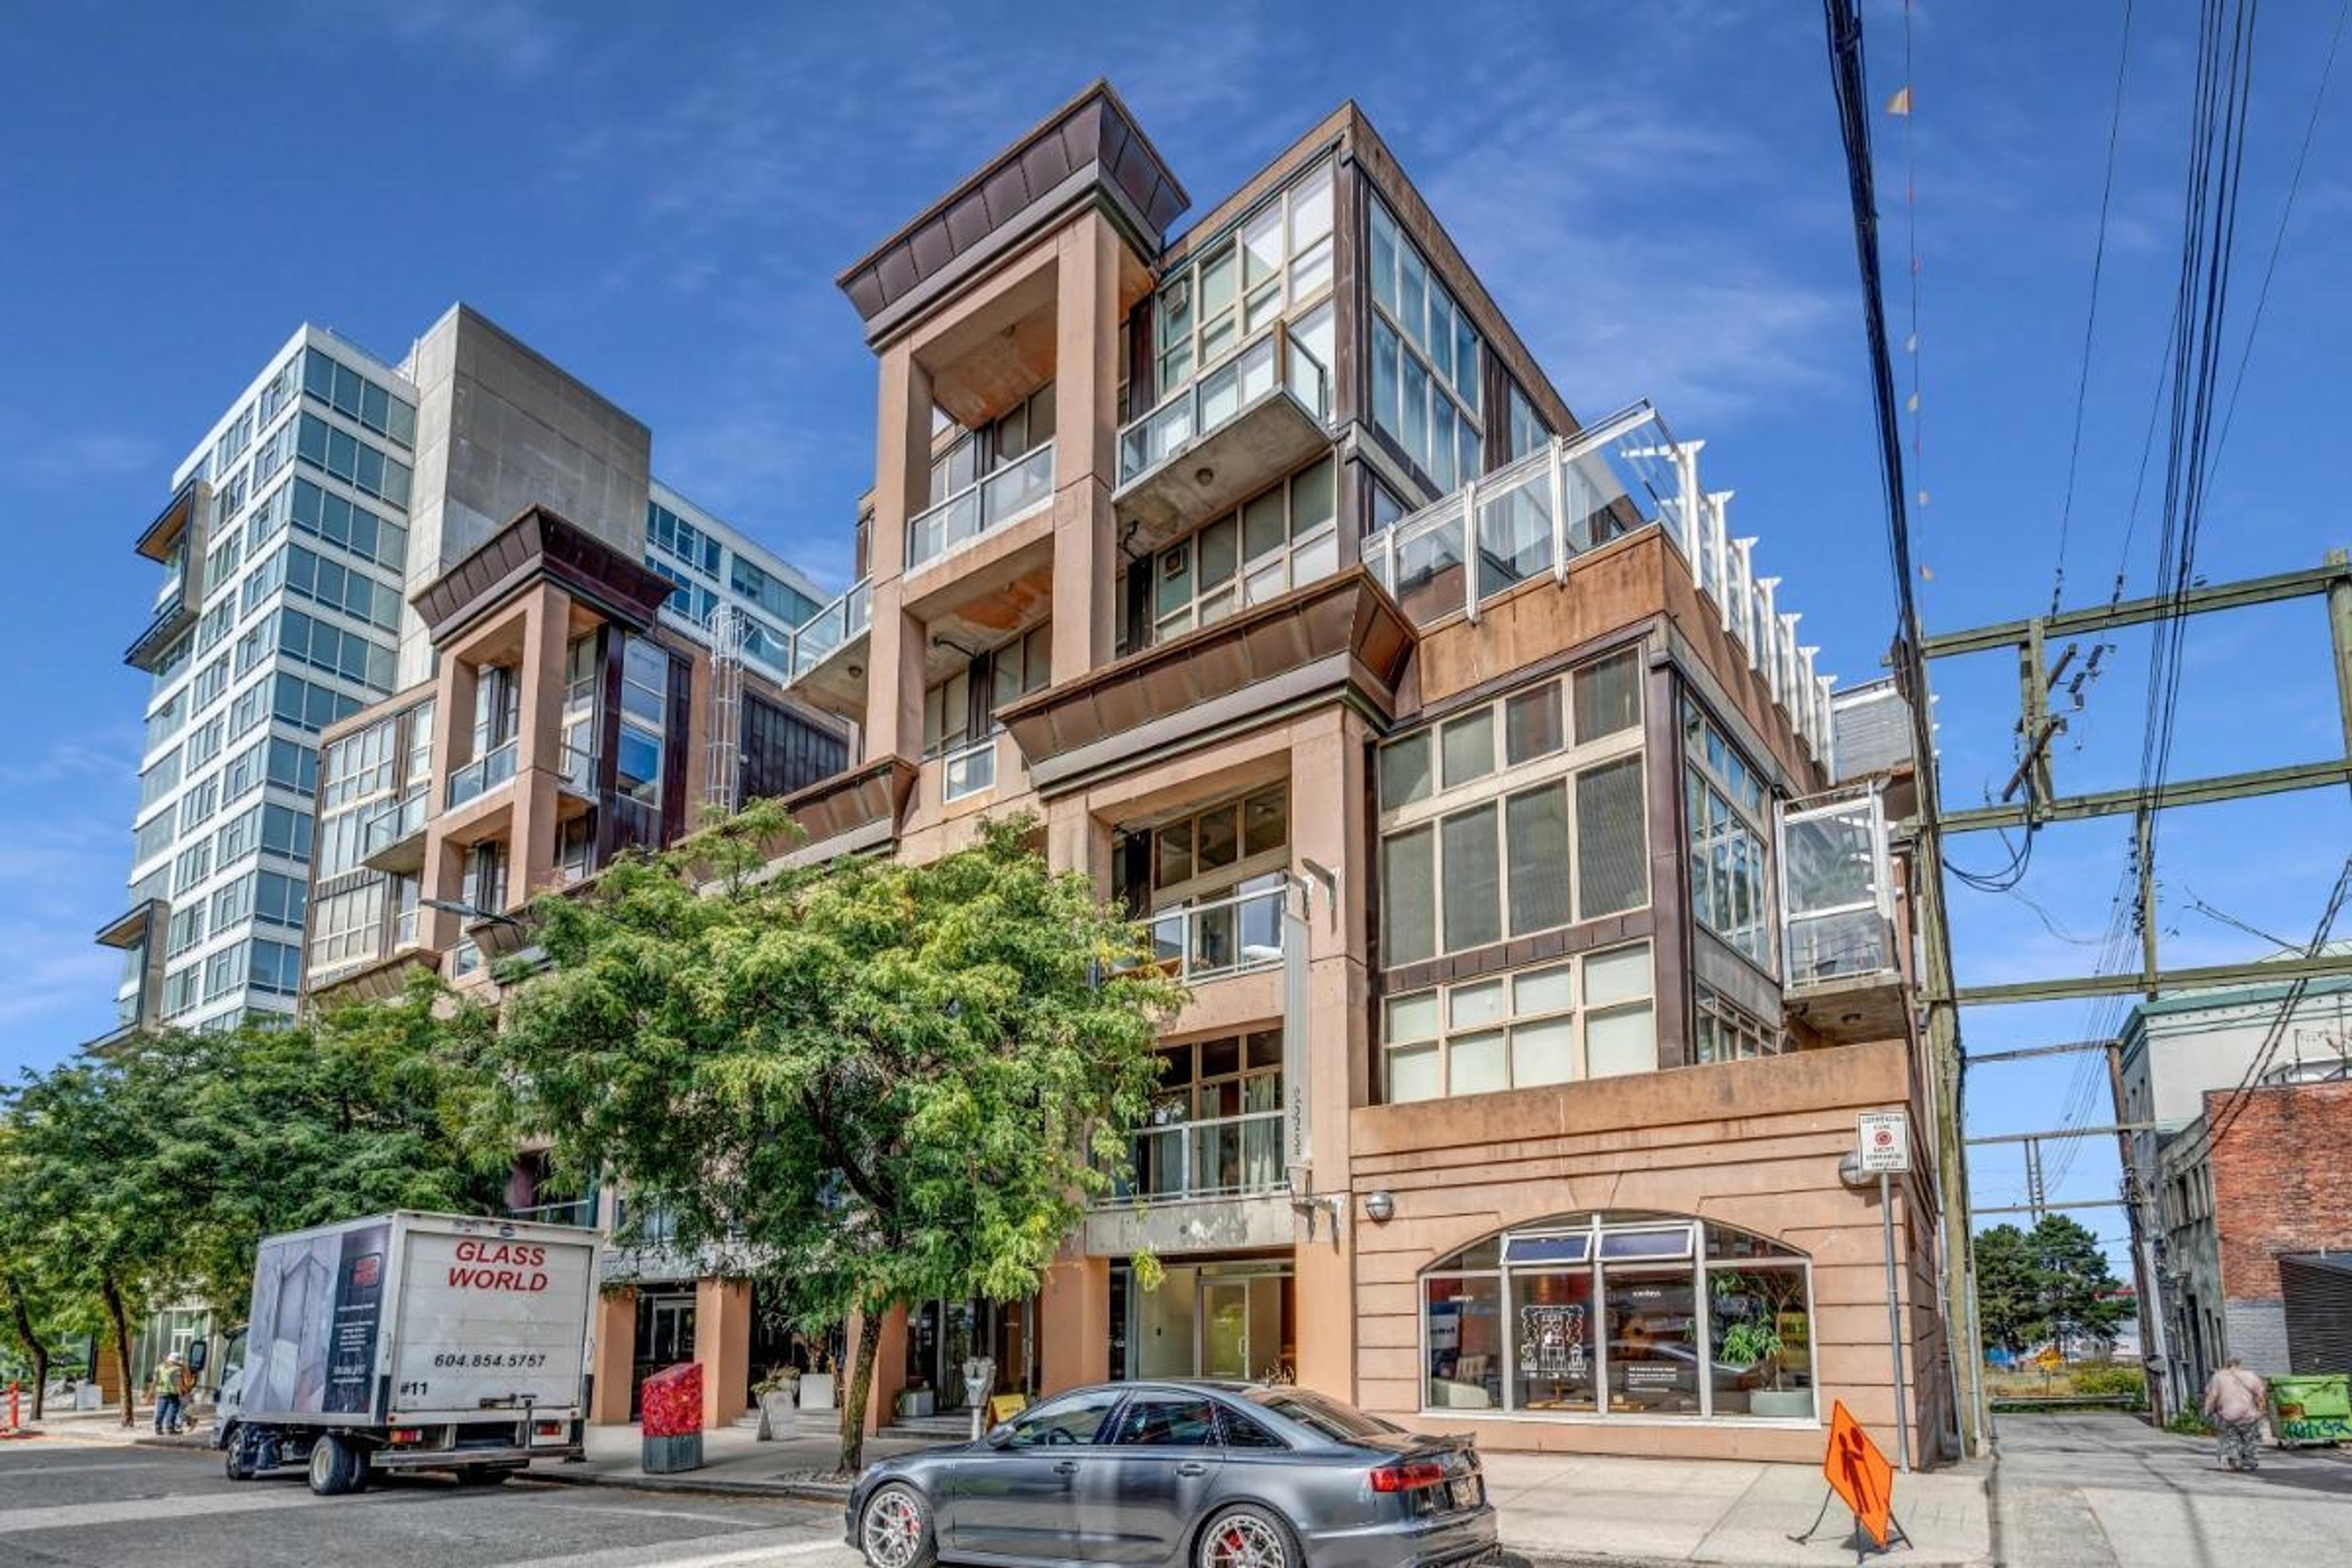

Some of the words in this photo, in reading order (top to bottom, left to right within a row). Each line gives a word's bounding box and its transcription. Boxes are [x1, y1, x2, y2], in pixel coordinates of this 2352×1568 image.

[456, 1242, 546, 1267] GLASS
[448, 1268, 548, 1291] WORLD
[434, 1354, 546, 1368] 604.854.5757
[399, 1381, 428, 1396] #11
